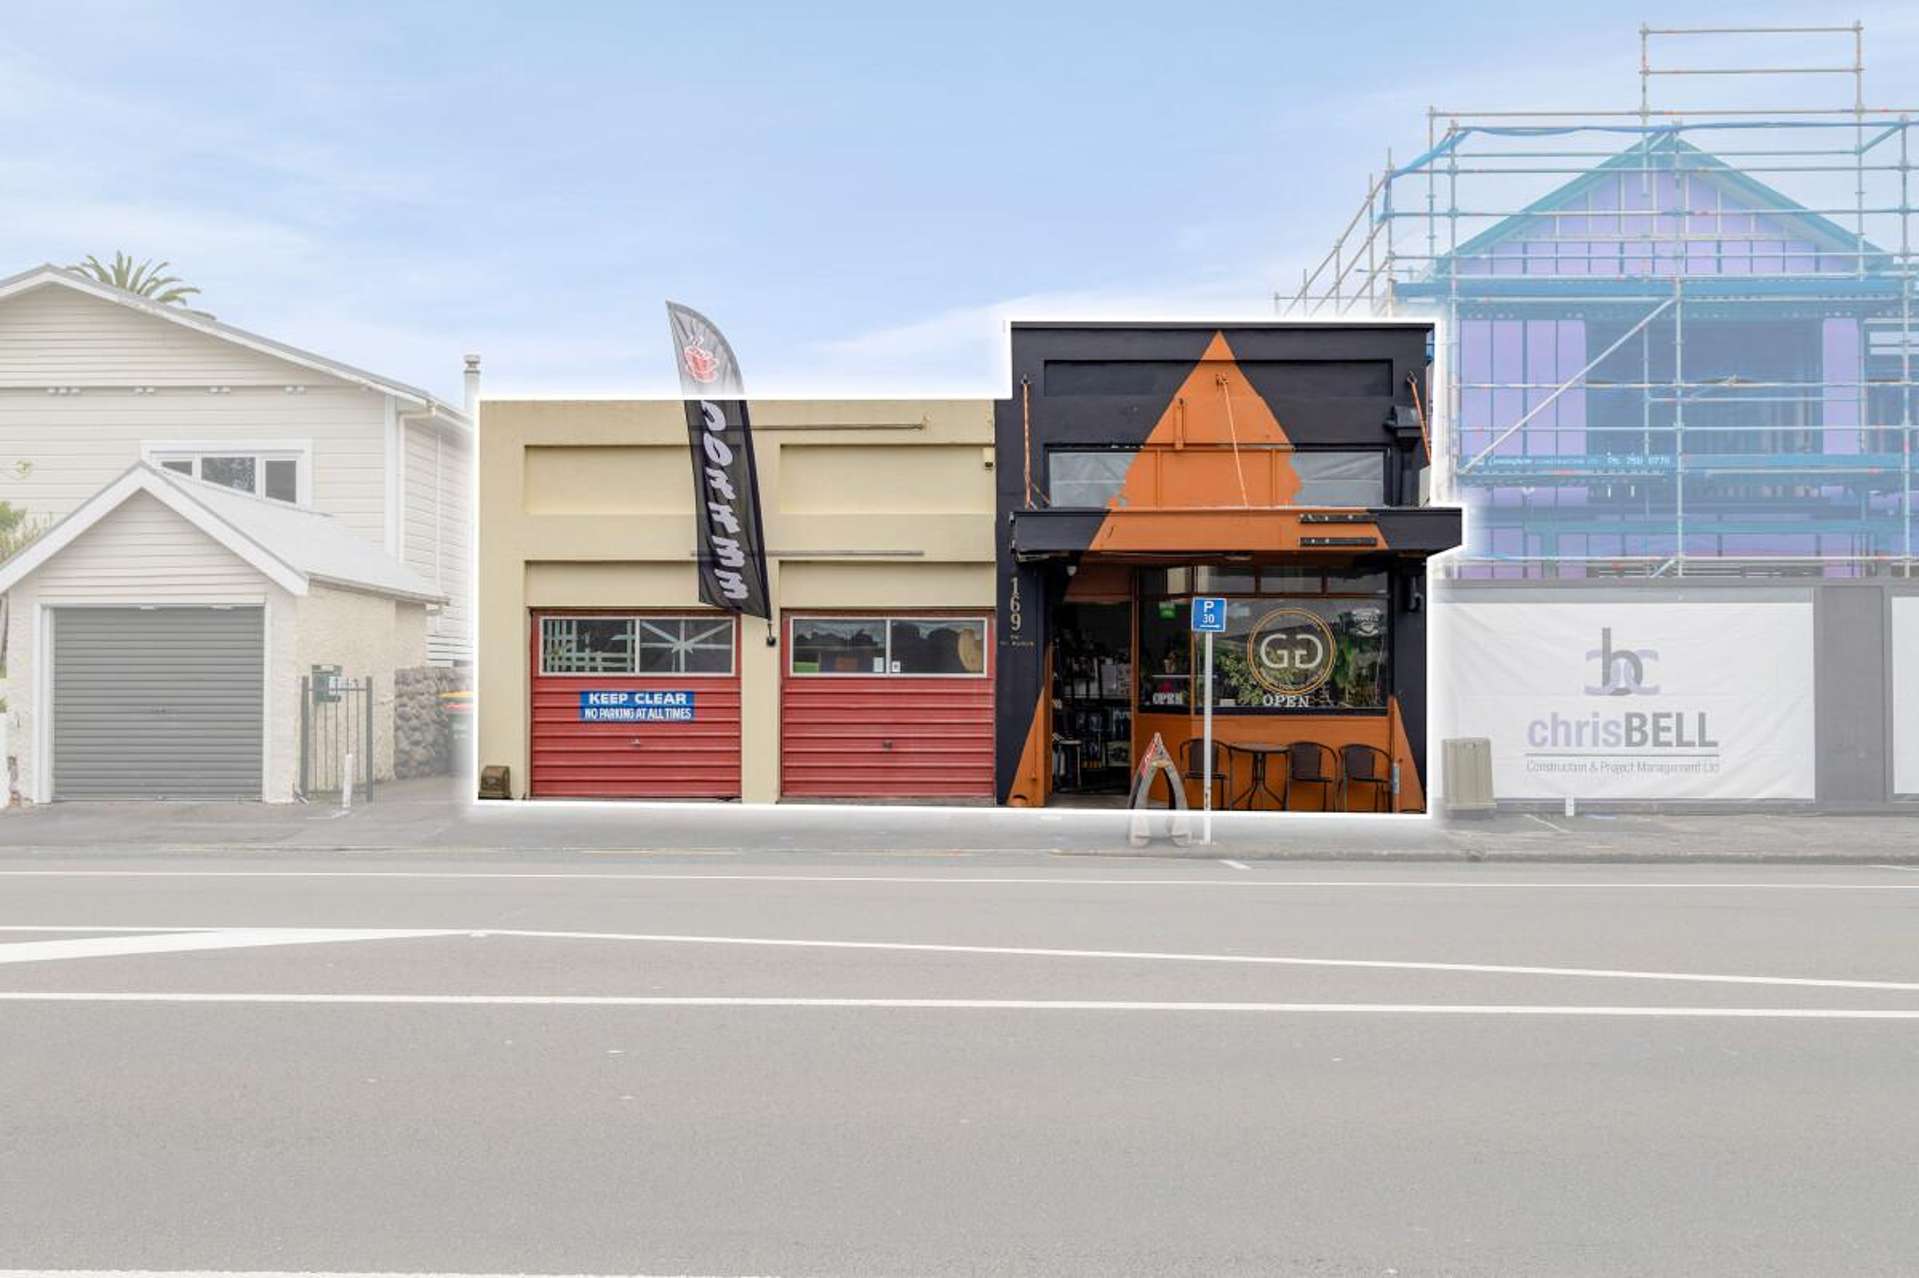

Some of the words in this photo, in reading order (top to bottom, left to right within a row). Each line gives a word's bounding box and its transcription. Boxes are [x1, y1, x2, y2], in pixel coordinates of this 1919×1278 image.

[1009, 577, 1021, 631] 169
[1203, 600, 1215, 613] P
[1202, 614, 1215, 624] 30
[588, 692, 628, 705] KEEP
[634, 692, 687, 705] CLEAR
[1262, 693, 1310, 708] OPEN
[584, 707, 598, 720] NO
[599, 707, 634, 720] PARKING
[635, 707, 647, 720] AT
[647, 707, 664, 720] ALL
[665, 707, 692, 720] TIMES
[1527, 711, 1719, 748] chrisBELL
[1589, 760, 1598, 772] &
